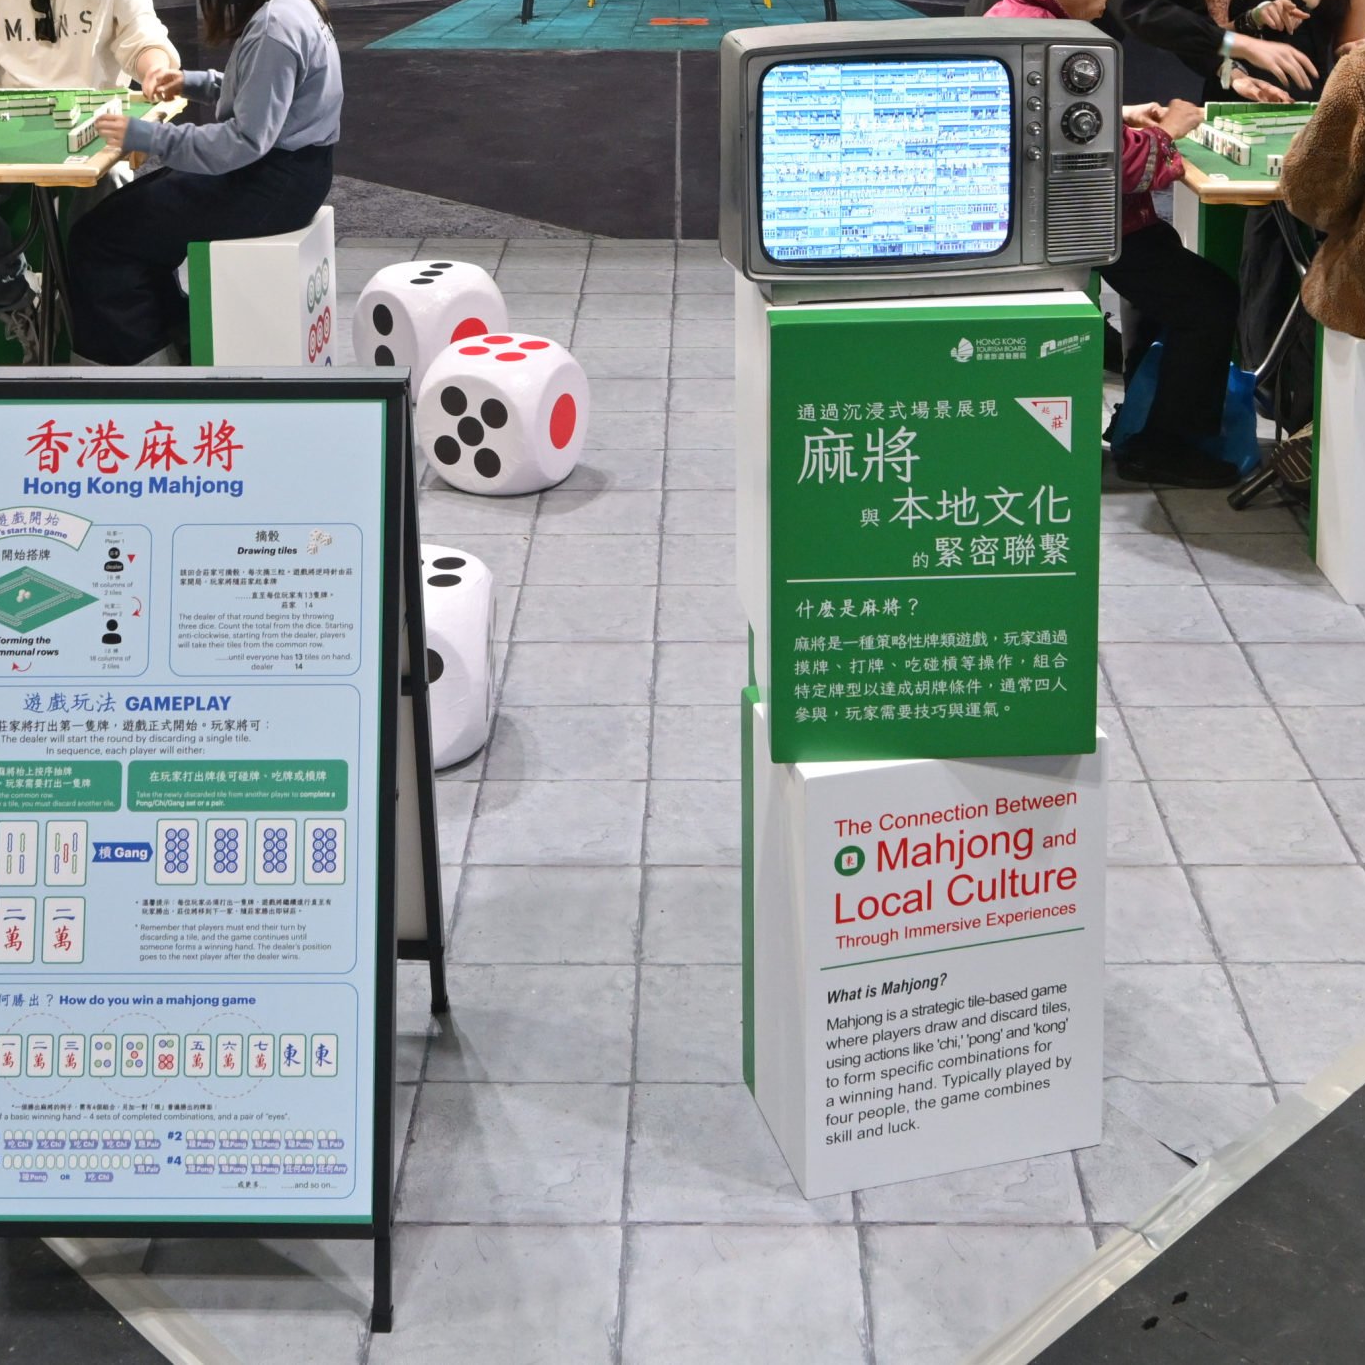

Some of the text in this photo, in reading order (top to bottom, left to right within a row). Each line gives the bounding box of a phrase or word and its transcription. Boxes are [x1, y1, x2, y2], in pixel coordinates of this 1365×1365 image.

[797, 400, 997, 421] 通過沉浸式場景展現
[26, 420, 243, 474] 香港麻將
[798, 426, 920, 483] 麻將
[24, 476, 243, 498] Hong Kong Mahjong
[861, 485, 1070, 529] 與本地文化
[44, 529, 68, 540] game
[256, 531, 279, 542] 摘骰
[2, 549, 50, 563] 開始搭牌
[238, 547, 275, 556] Drawing
[36, 636, 50, 644] the
[23, 692, 232, 713] 遊戲玩法 GAMEPLAY
[20, 735, 47, 743] dealer
[50, 734, 64, 742] will
[90, 734, 104, 742] the
[136, 735, 146, 744] by
[149, 735, 195, 744] discarding
[207, 734, 232, 744] single
[236, 734, 251, 742] tile.
[106, 746, 127, 754] each
[130, 746, 156, 755] player
[160, 746, 174, 754] will
[177, 746, 204, 754] either:
[835, 793, 1076, 836] The Connection Between
[98, 846, 148, 861] 槓 Gang
[878, 828, 1076, 872] Mahjong and
[836, 867, 1077, 924] Local Culture
[3, 908, 26, 952] 二萬
[52, 908, 75, 952] 二萬
[836, 904, 1076, 949] Through Immersive Experiences
[60, 996, 86, 1004] How
[89, 995, 104, 1004] do
[108, 998, 129, 1006] you
[133, 995, 153, 1004] win
[166, 995, 219, 1006] mahjong
[222, 998, 256, 1006] game
[828, 973, 947, 1004] What is Mahjong?
[827, 984, 1067, 1031] Mahjong is a strategic tile-based game
[826, 1002, 1070, 1050] where players draw and discard tiles,
[827, 1018, 1068, 1069] using actions like 'chi,' 'pong' and 'kong'
[826, 1041, 1052, 1088] to form specific combinations for
[826, 1056, 1071, 1107] a winning hand. Typically played by
[826, 1079, 1050, 1126] four people, the game combines
[167, 1131, 182, 1141] #2
[826, 1119, 919, 1145] skill and luck.
[167, 1156, 182, 1165] #4
